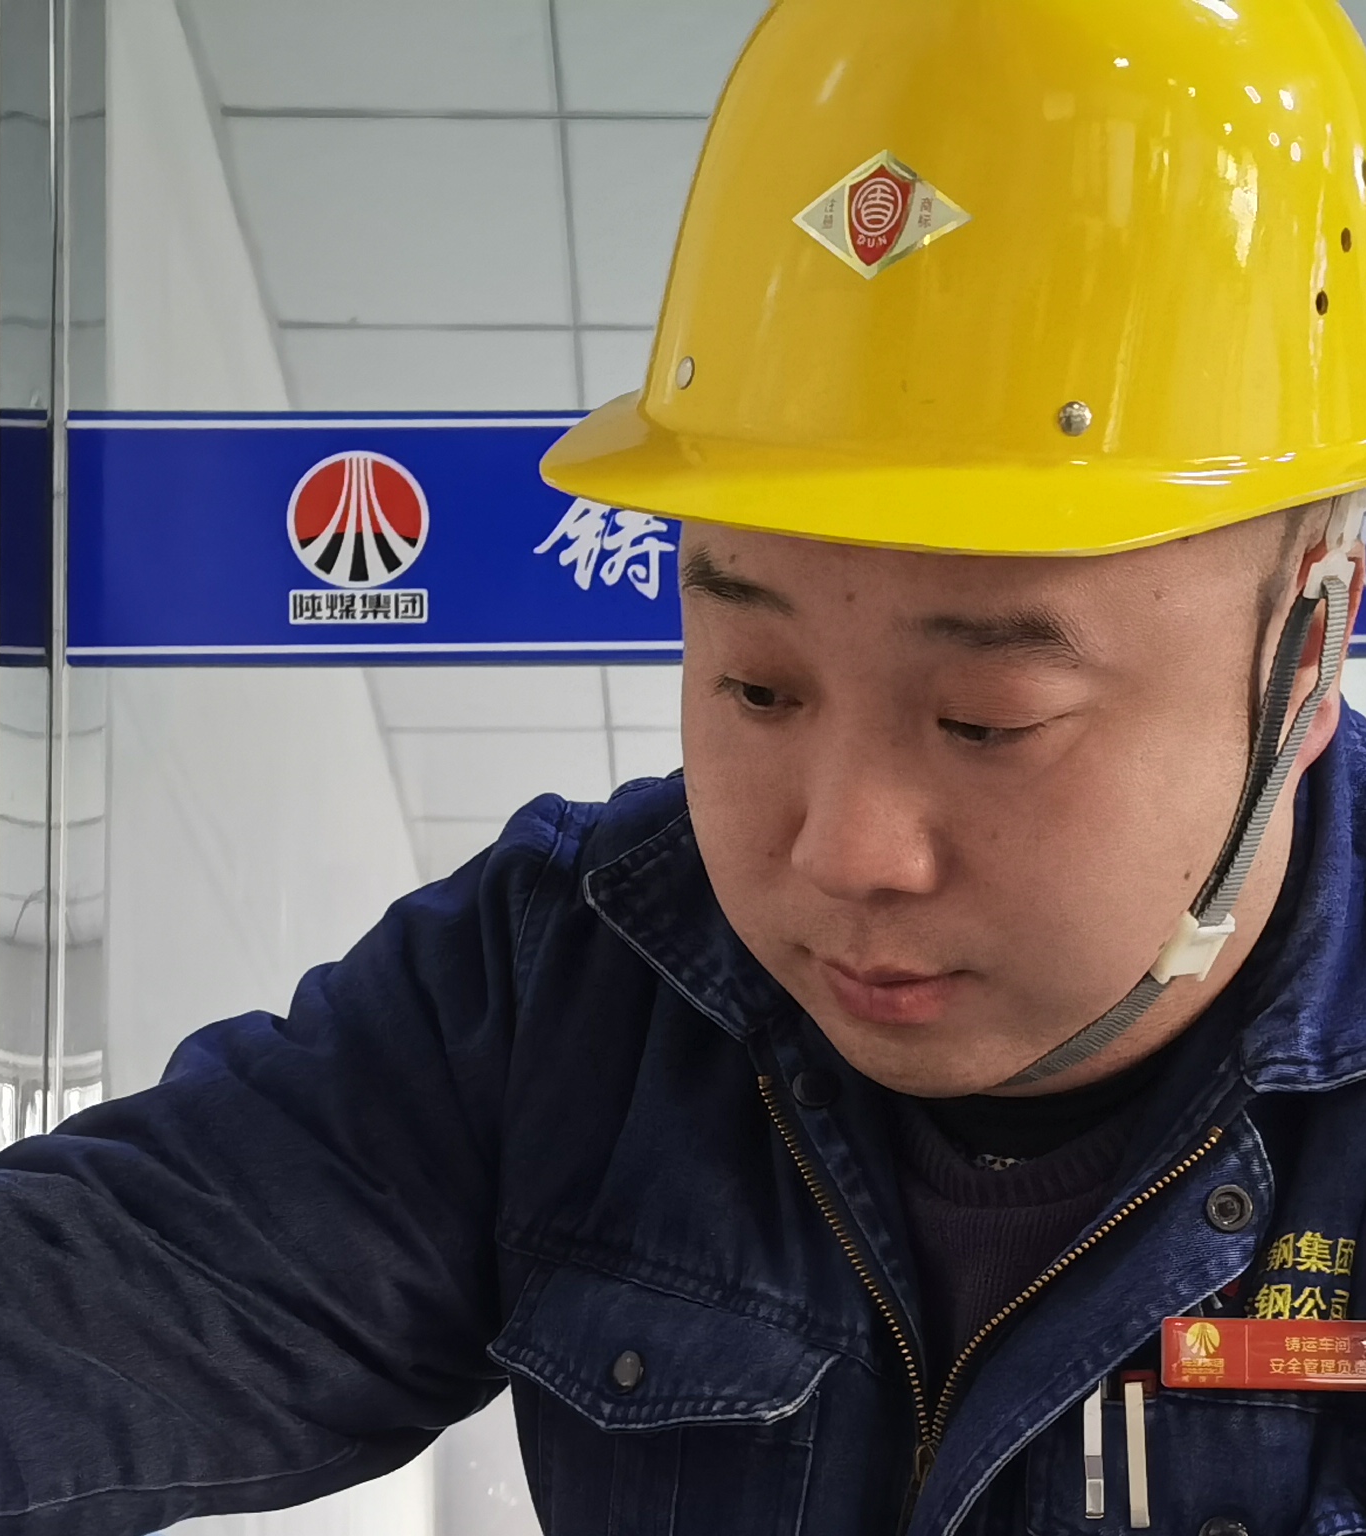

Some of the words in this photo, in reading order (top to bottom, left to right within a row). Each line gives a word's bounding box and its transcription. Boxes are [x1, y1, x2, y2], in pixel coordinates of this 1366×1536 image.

[292, 592, 424, 621] 陕煤集团
[1246, 1283, 1350, 1320] 钢公司
